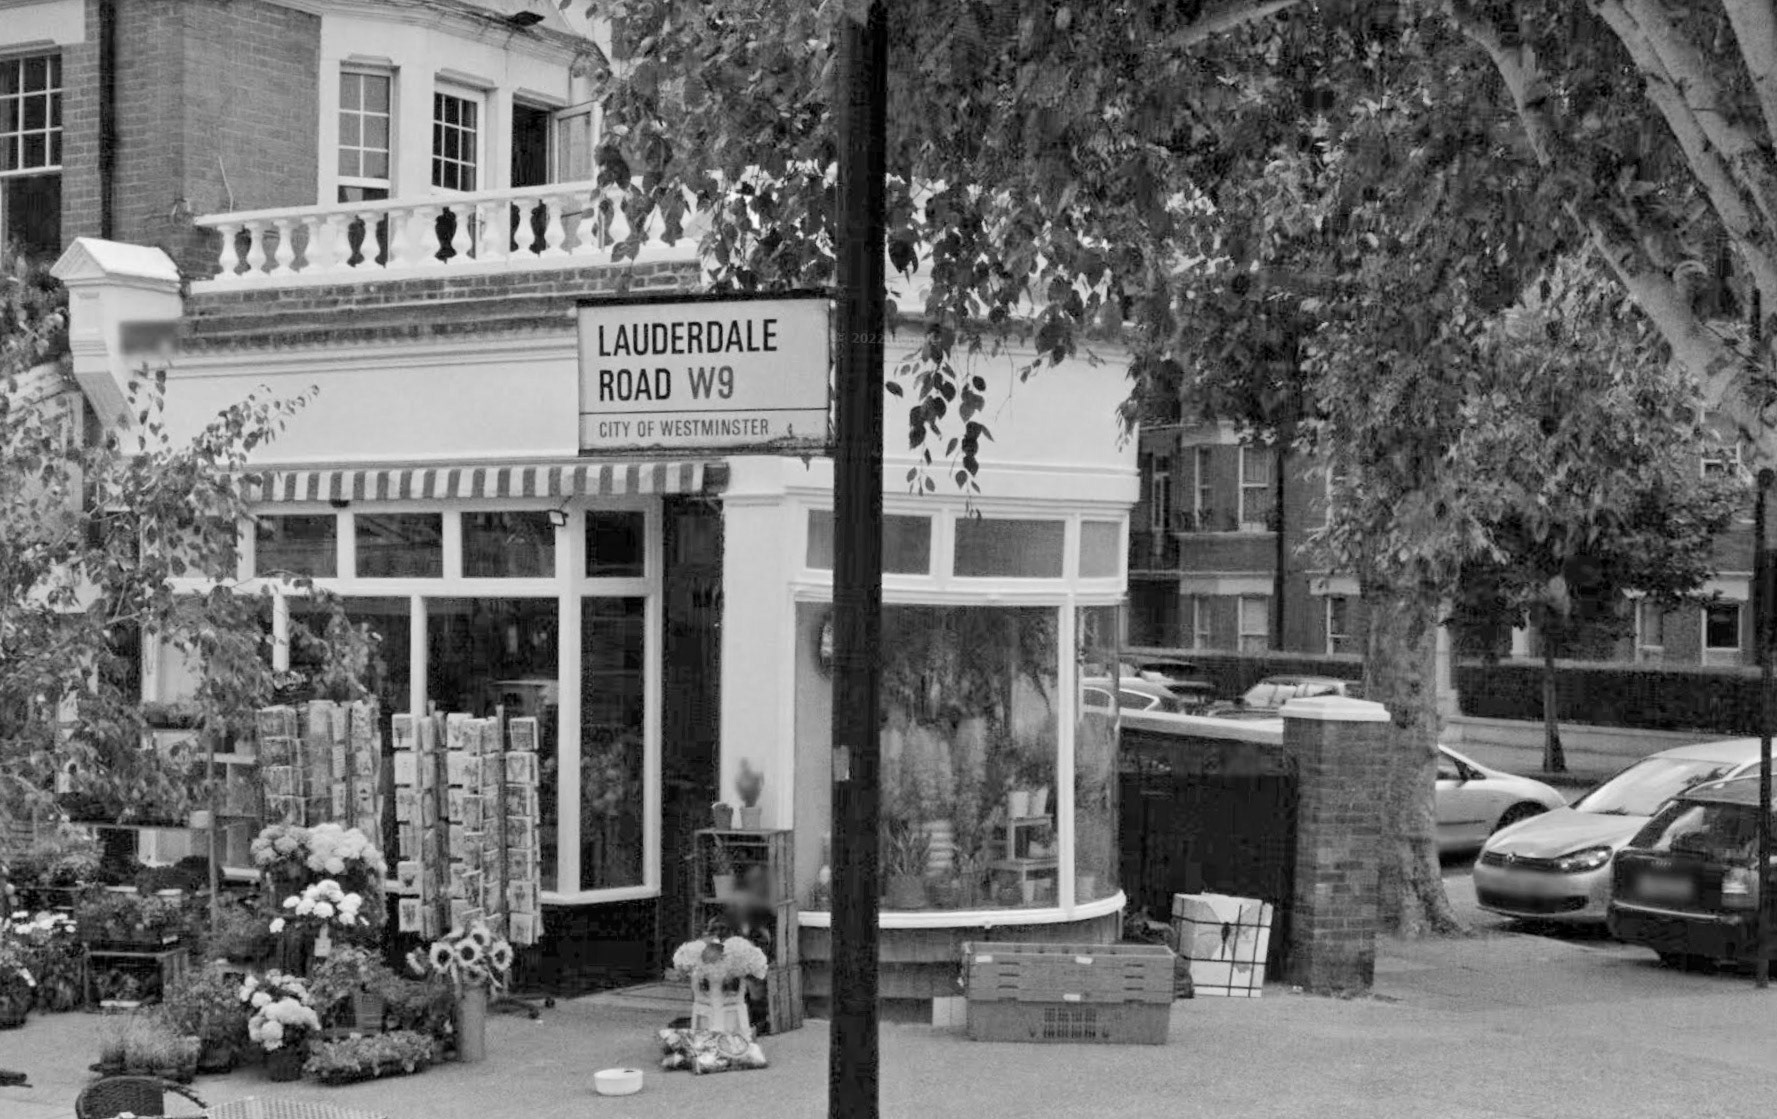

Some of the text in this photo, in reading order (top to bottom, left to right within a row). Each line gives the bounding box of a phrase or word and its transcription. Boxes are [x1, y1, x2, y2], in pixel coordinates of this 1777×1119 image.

[598, 318, 778, 357] LAUDERDALE
[599, 365, 734, 402] ROAD W9
[599, 418, 769, 438] CITY OF WESTMINSTER
